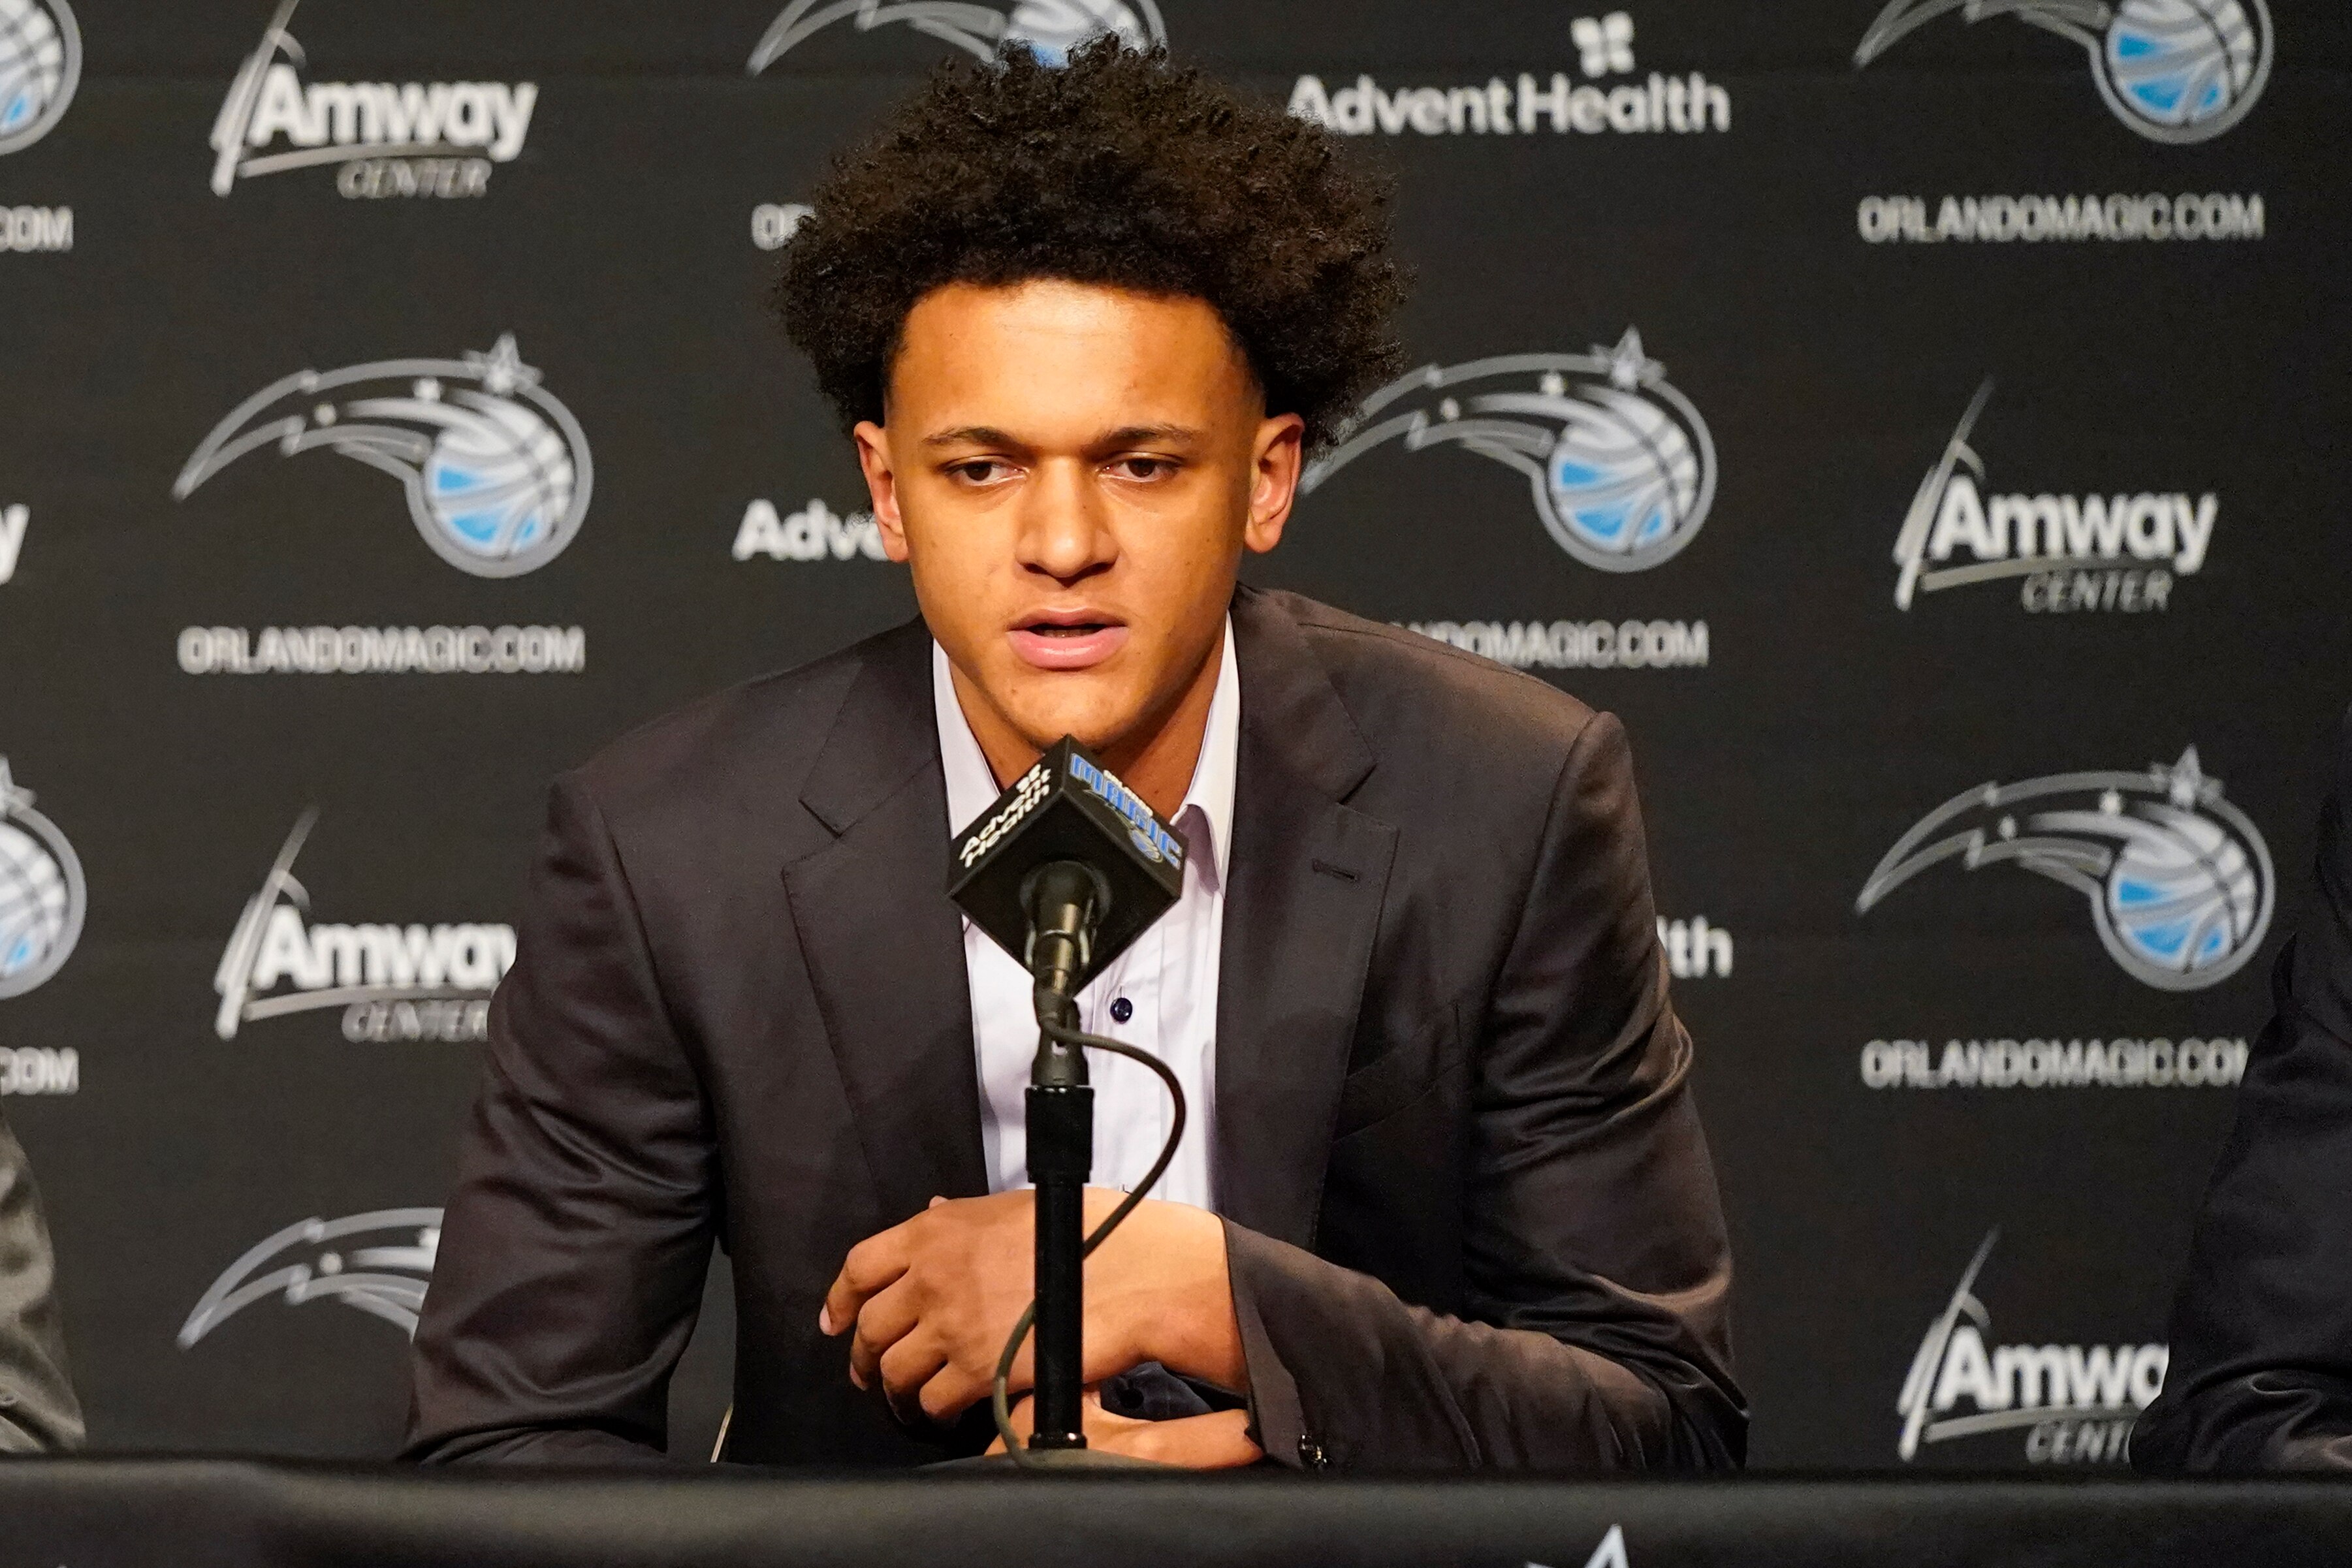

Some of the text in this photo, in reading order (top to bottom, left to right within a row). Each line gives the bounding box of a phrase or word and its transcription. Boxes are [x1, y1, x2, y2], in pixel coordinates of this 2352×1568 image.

[246, 63, 538, 162] Amway
[1286, 73, 1730, 134] AdventHealth
[337, 158, 492, 198] CENTER
[1857, 194, 2265, 243] ORLANDOMAGIC.COM
[1928, 475, 2217, 574] Amway
[2021, 570, 2174, 612] CENTER
[178, 625, 585, 674] ORLANDOMAGIC.COM
[959, 768, 1051, 860] Advent
[964, 784, 1049, 868] Health
[2026, 1419, 2130, 1463] CENT
